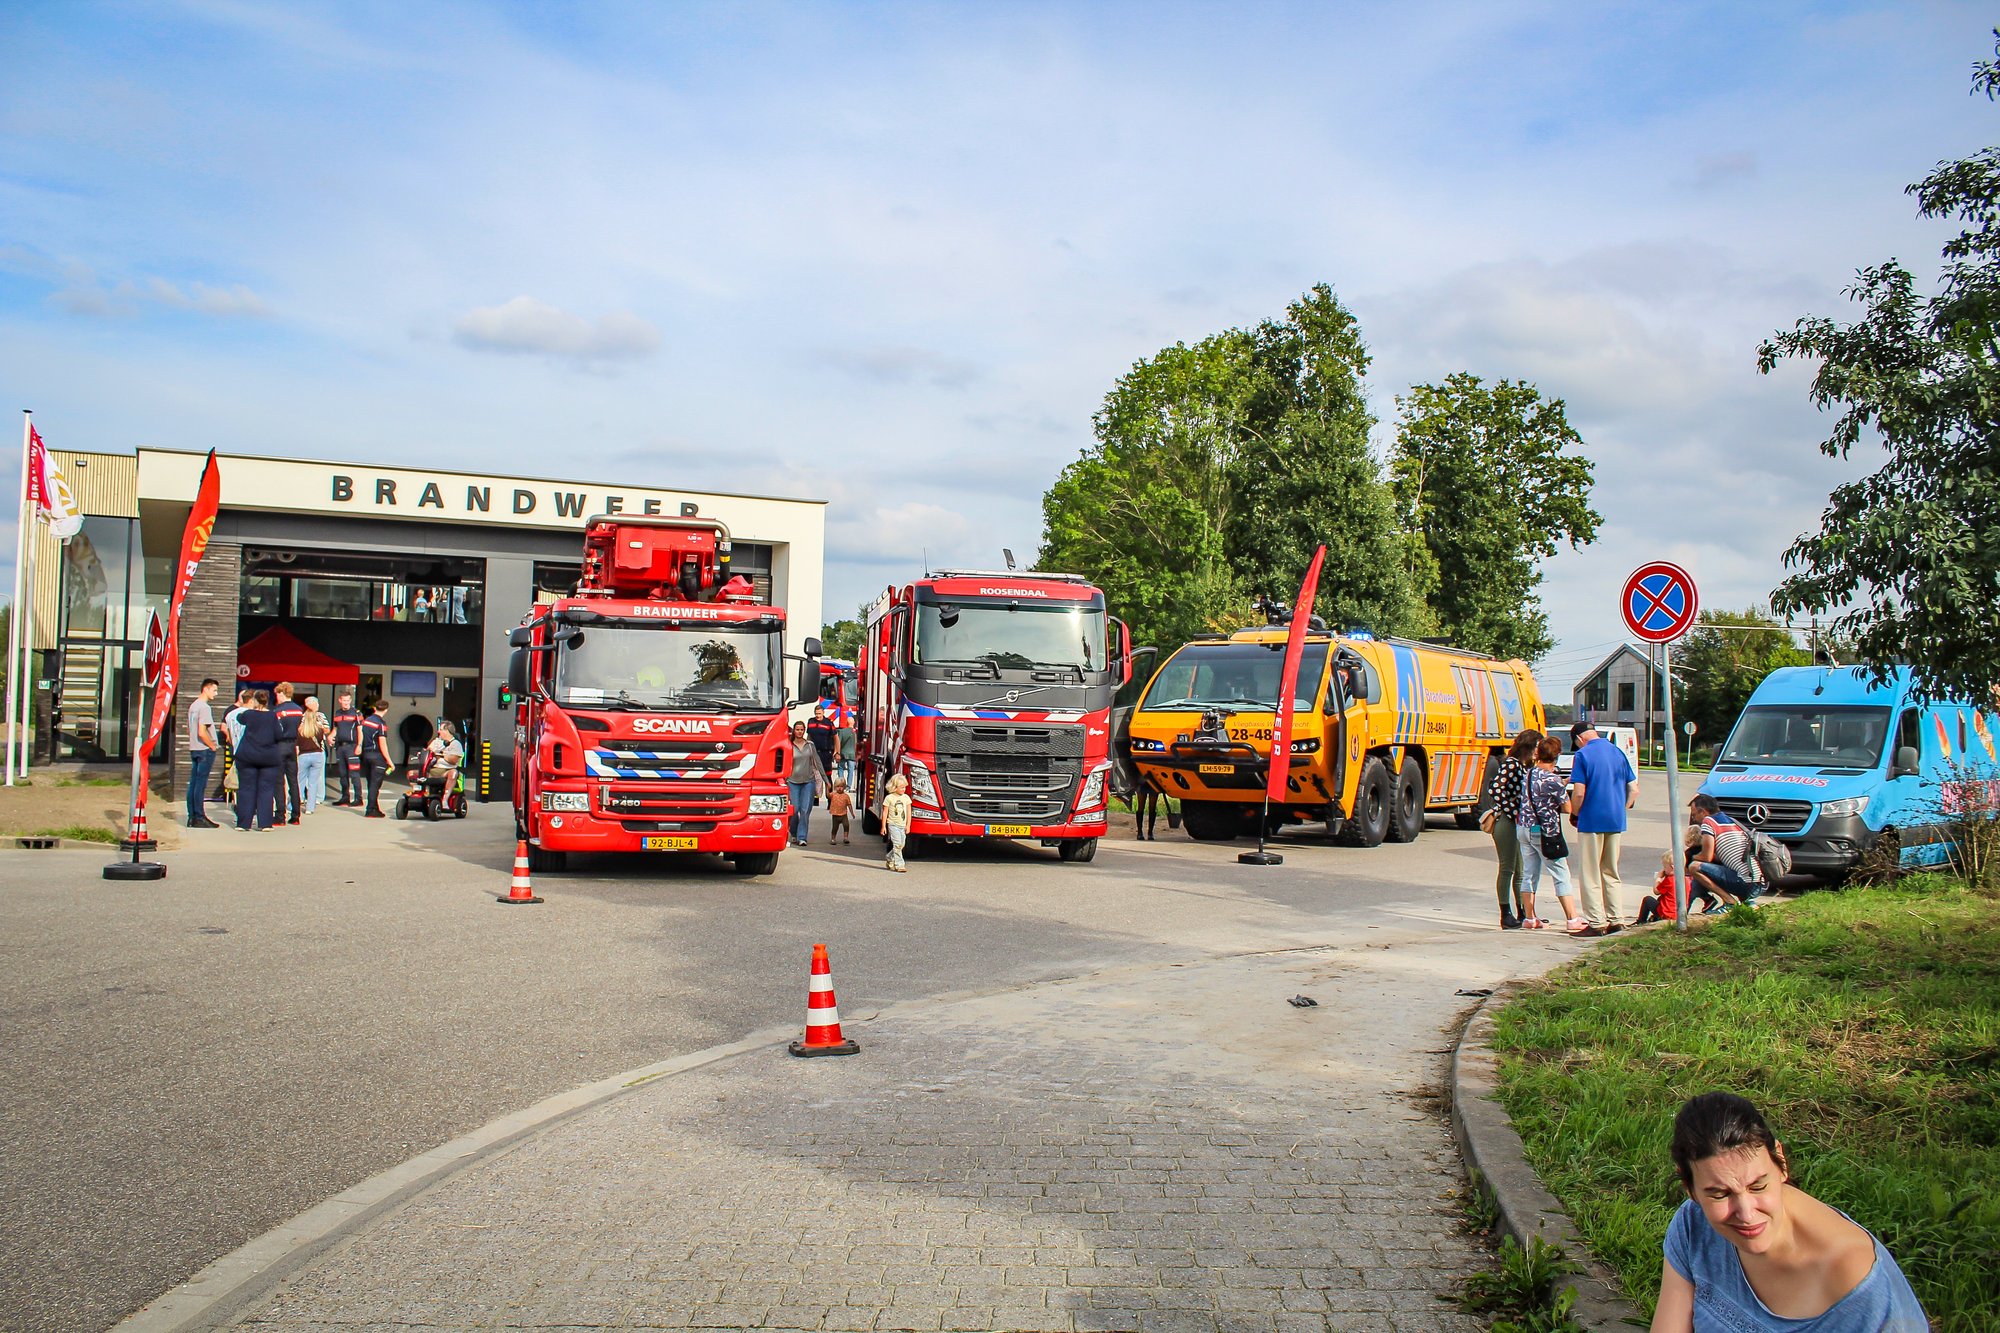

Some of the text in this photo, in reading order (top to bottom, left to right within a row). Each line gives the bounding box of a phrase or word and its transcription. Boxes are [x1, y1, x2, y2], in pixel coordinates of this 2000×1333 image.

[332, 475, 700, 518] BRANDWEER
[980, 587, 1048, 597] ROOSENDAAL
[633, 605, 718, 619] BRANDWEER
[632, 718, 712, 734] SCANIA
[1427, 721, 1447, 734] 28-4861
[1231, 728, 1273, 741] 28-48
[1719, 774, 1829, 787] WILHELMUS
[620, 799, 641, 807] 450
[991, 826, 1028, 834] 84-BRK-7
[651, 838, 693, 848] 92-BJL-4
